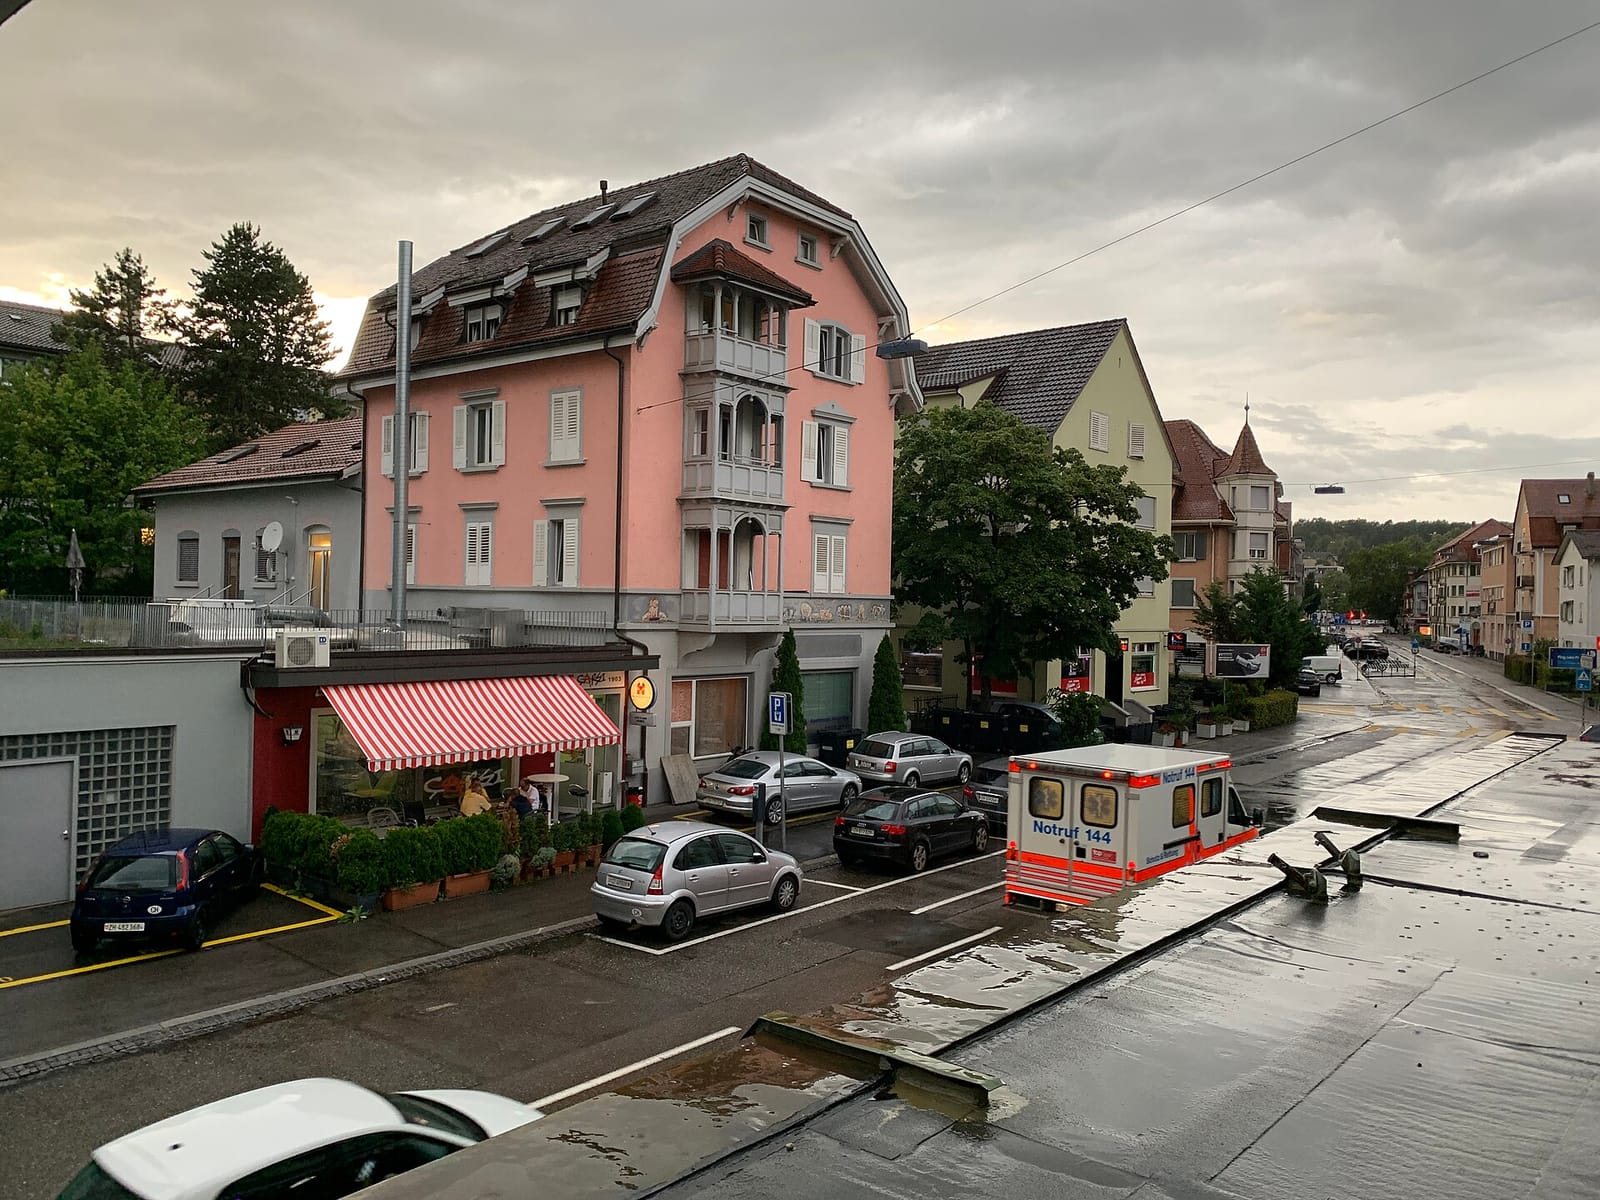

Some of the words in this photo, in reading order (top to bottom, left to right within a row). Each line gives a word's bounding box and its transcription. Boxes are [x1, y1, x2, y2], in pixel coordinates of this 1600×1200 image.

[775, 698, 780, 710] P
[1162, 769, 1182, 784] Notruf
[1184, 767, 1195, 779] 144
[1033, 820, 1079, 839] Notruf
[1085, 828, 1111, 844] 144
